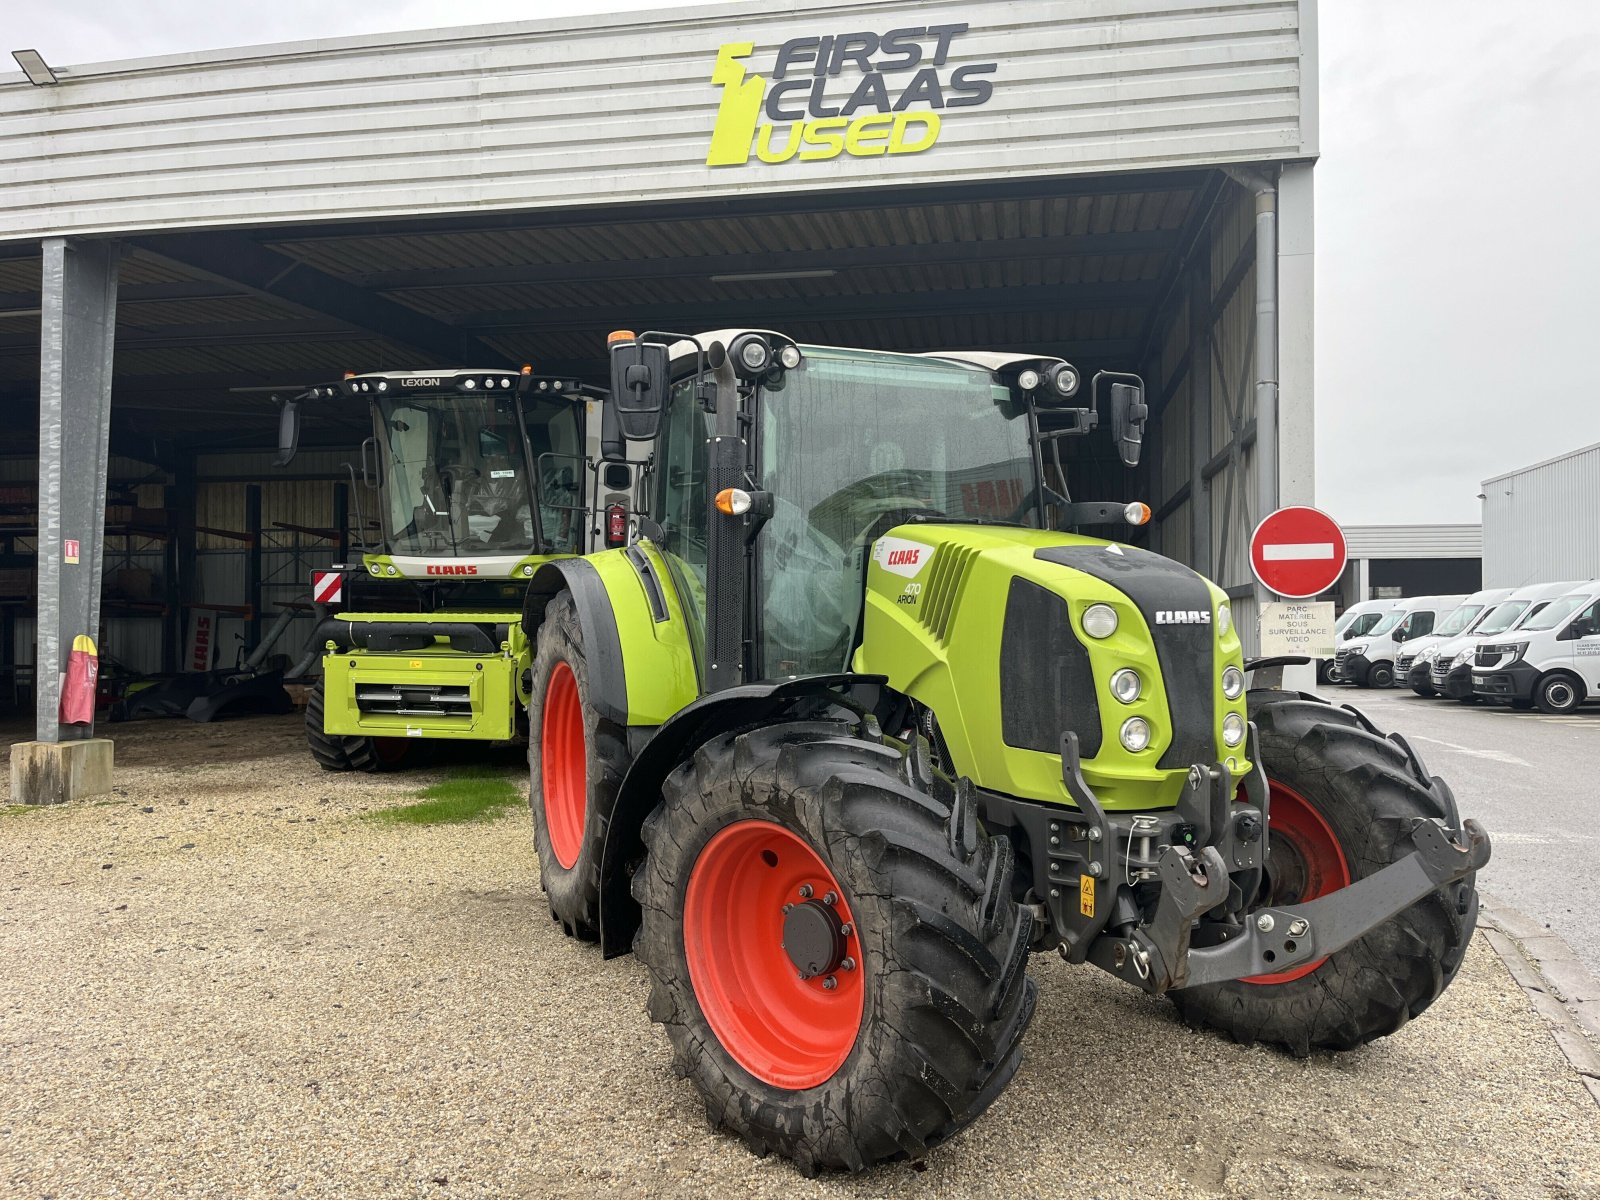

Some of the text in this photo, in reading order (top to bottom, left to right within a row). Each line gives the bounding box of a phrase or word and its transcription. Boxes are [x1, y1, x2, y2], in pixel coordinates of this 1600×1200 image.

[773, 23, 968, 79] FIRST
[765, 63, 997, 120] CLAAS
[756, 111, 941, 163] USED
[401, 378, 440, 387] LEXION
[888, 549, 920, 565] CLAAS
[427, 565, 477, 575] CLAAS
[905, 583, 921, 595] 470
[897, 595, 917, 605] ARION
[1156, 611, 1210, 624] CLAAS
[193, 616, 209, 670] LAAS
